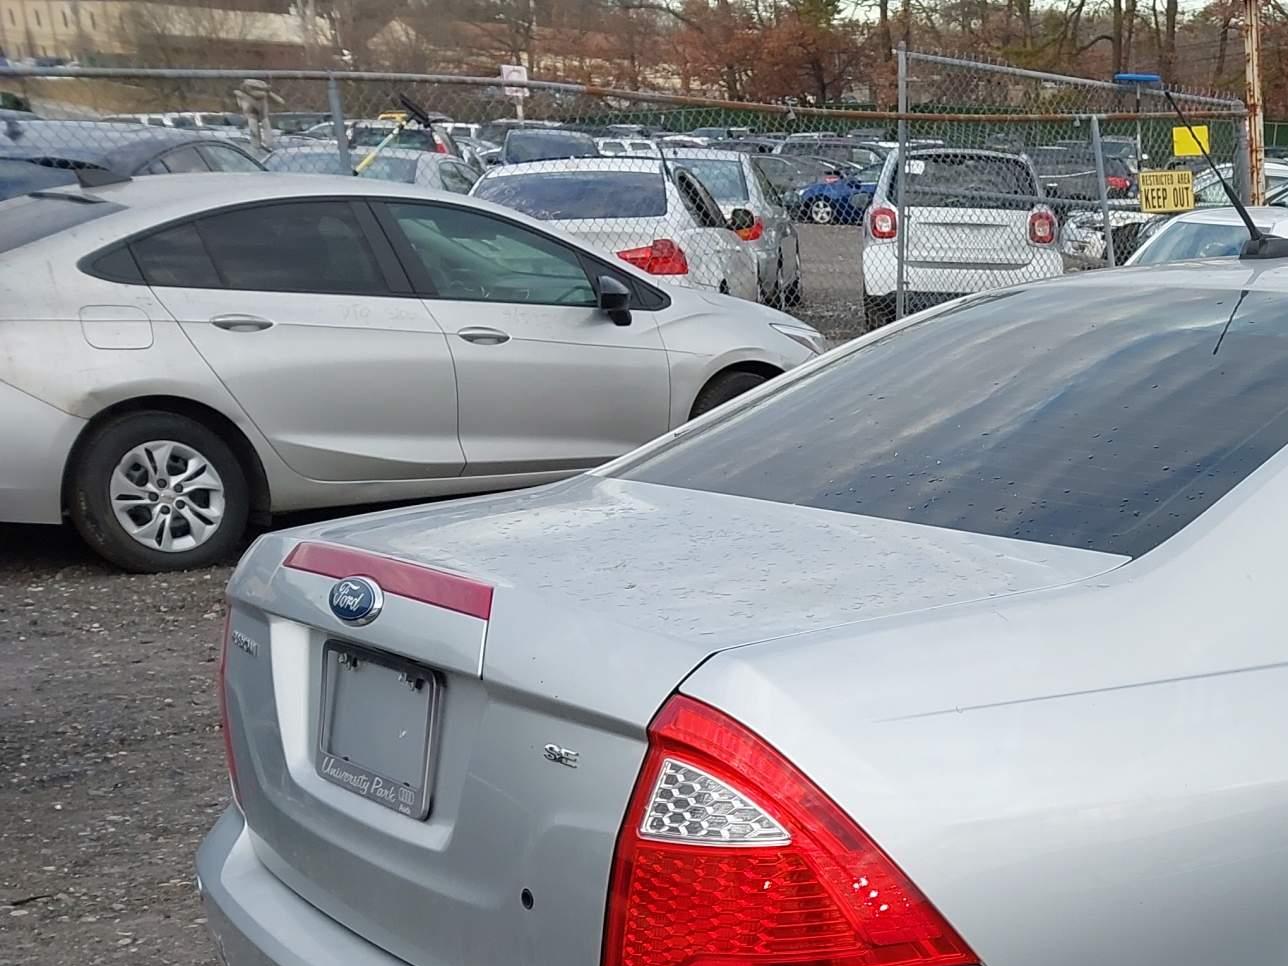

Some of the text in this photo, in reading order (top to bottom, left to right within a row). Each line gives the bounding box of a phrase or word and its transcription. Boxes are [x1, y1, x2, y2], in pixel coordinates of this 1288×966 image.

[1142, 173, 1190, 186] RESTRICTED AREA
[1144, 187, 1189, 208] KEEP OUT
[333, 581, 365, 612] Ford
[544, 743, 579, 769] SE
[370, 776, 396, 804] Park
